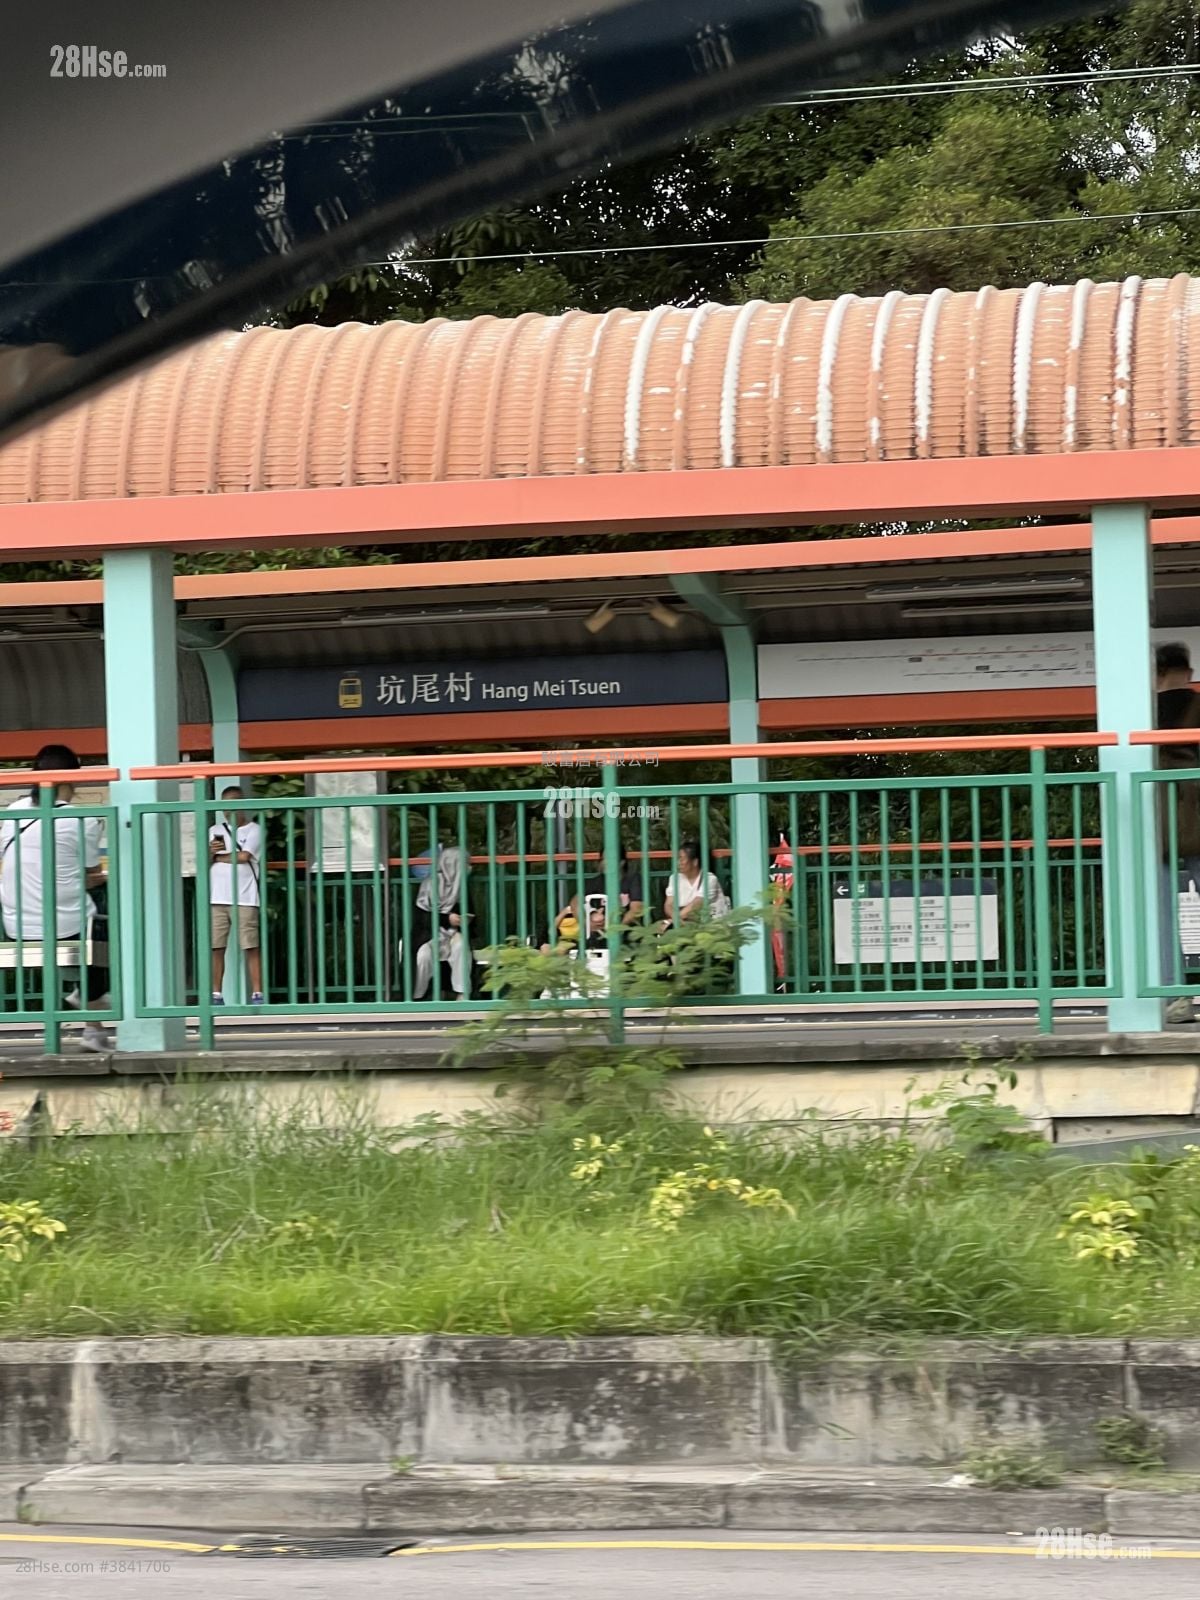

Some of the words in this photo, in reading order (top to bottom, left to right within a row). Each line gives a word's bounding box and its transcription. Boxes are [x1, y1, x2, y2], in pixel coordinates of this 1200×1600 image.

[376, 671, 475, 705] 坑尾村
[482, 682, 528, 702] Hang
[534, 680, 565, 697] Mei
[568, 678, 621, 696] Tsuen
